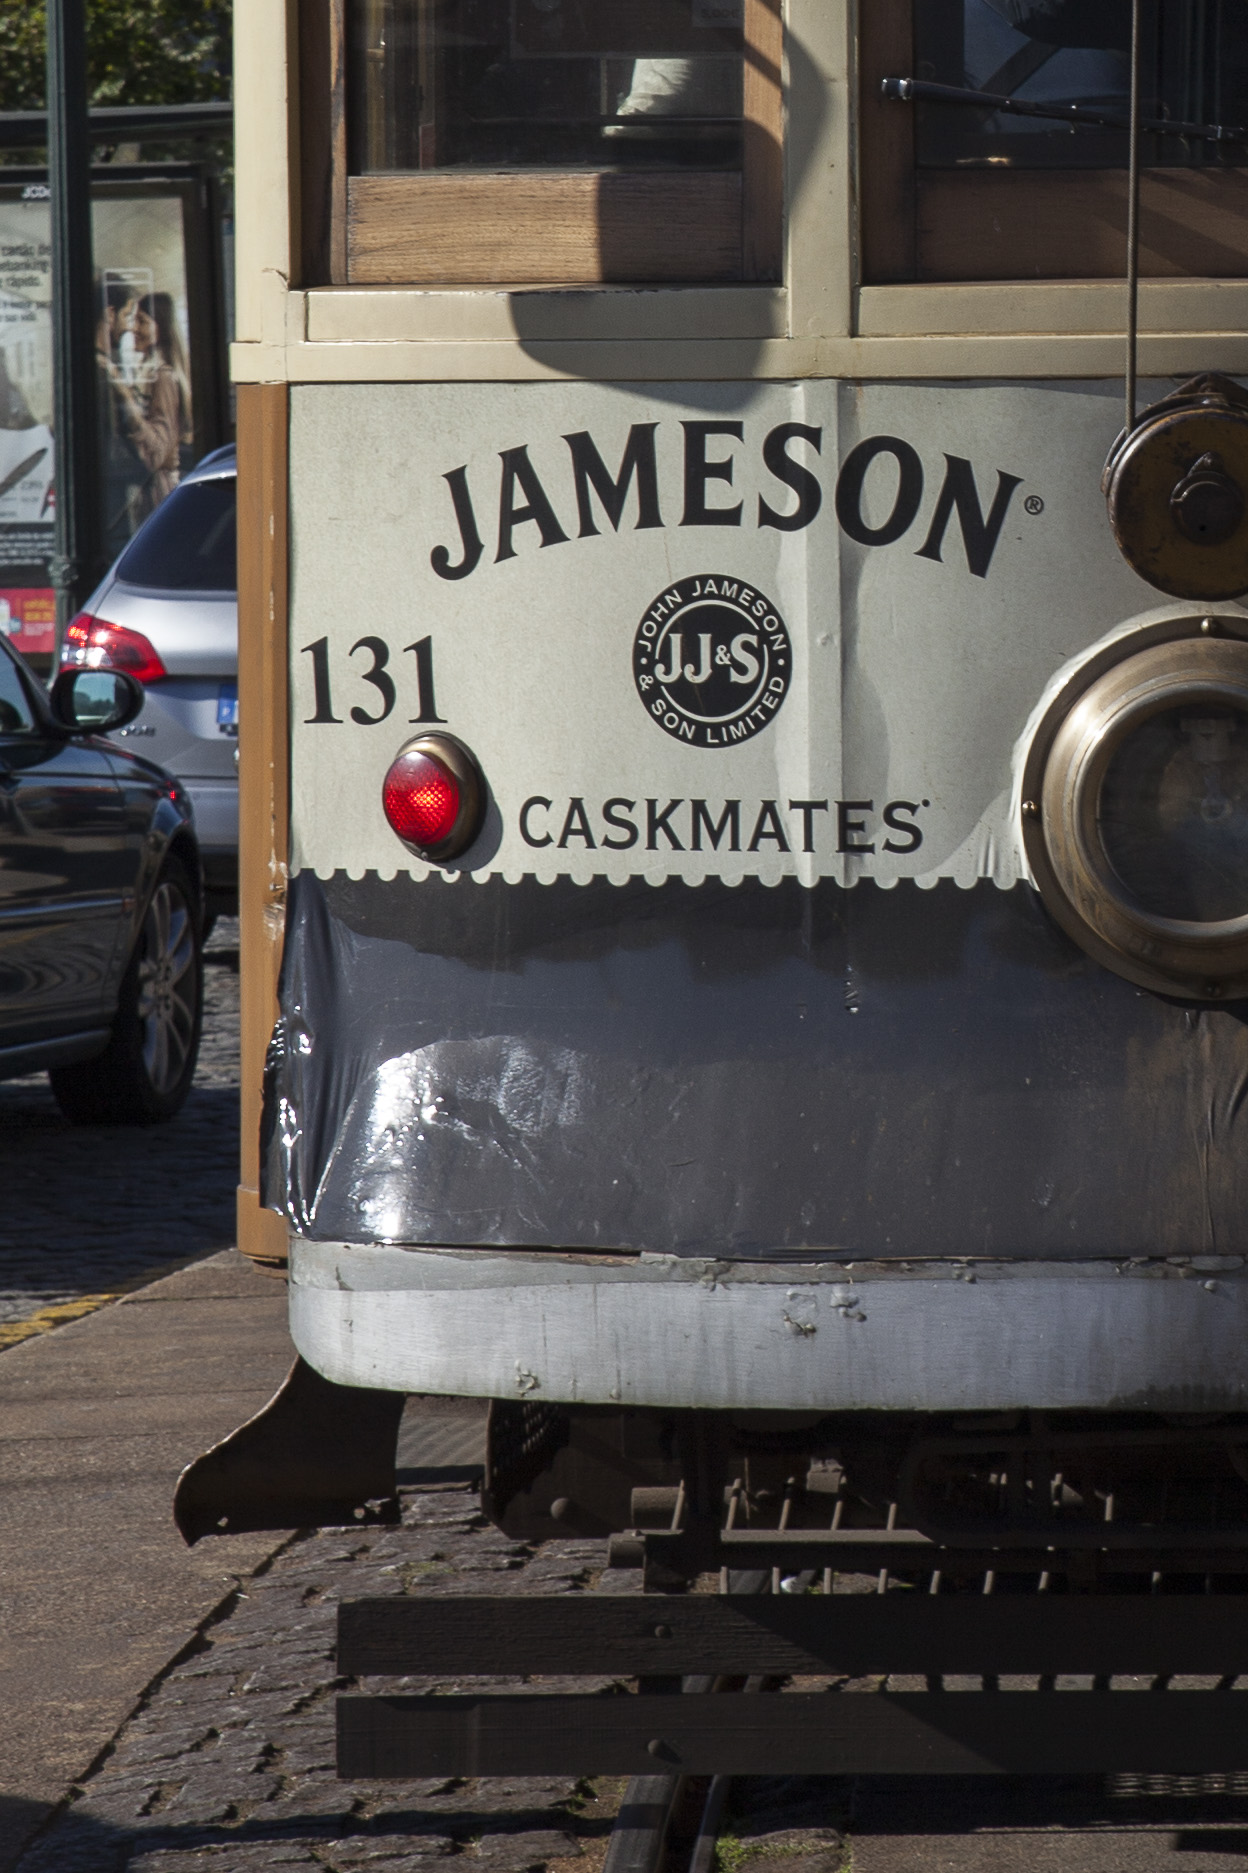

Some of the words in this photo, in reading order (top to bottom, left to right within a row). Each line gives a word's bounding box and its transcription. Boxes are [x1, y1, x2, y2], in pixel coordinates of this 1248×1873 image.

[638, 589, 684, 652] JOHN
[692, 579, 787, 652] JAMESON
[299, 634, 449, 726] 131
[654, 633, 760, 684] JJ&S
[651, 698, 696, 740] SON
[706, 676, 785, 744] LIMITED
[518, 795, 925, 856] CASKMATES
